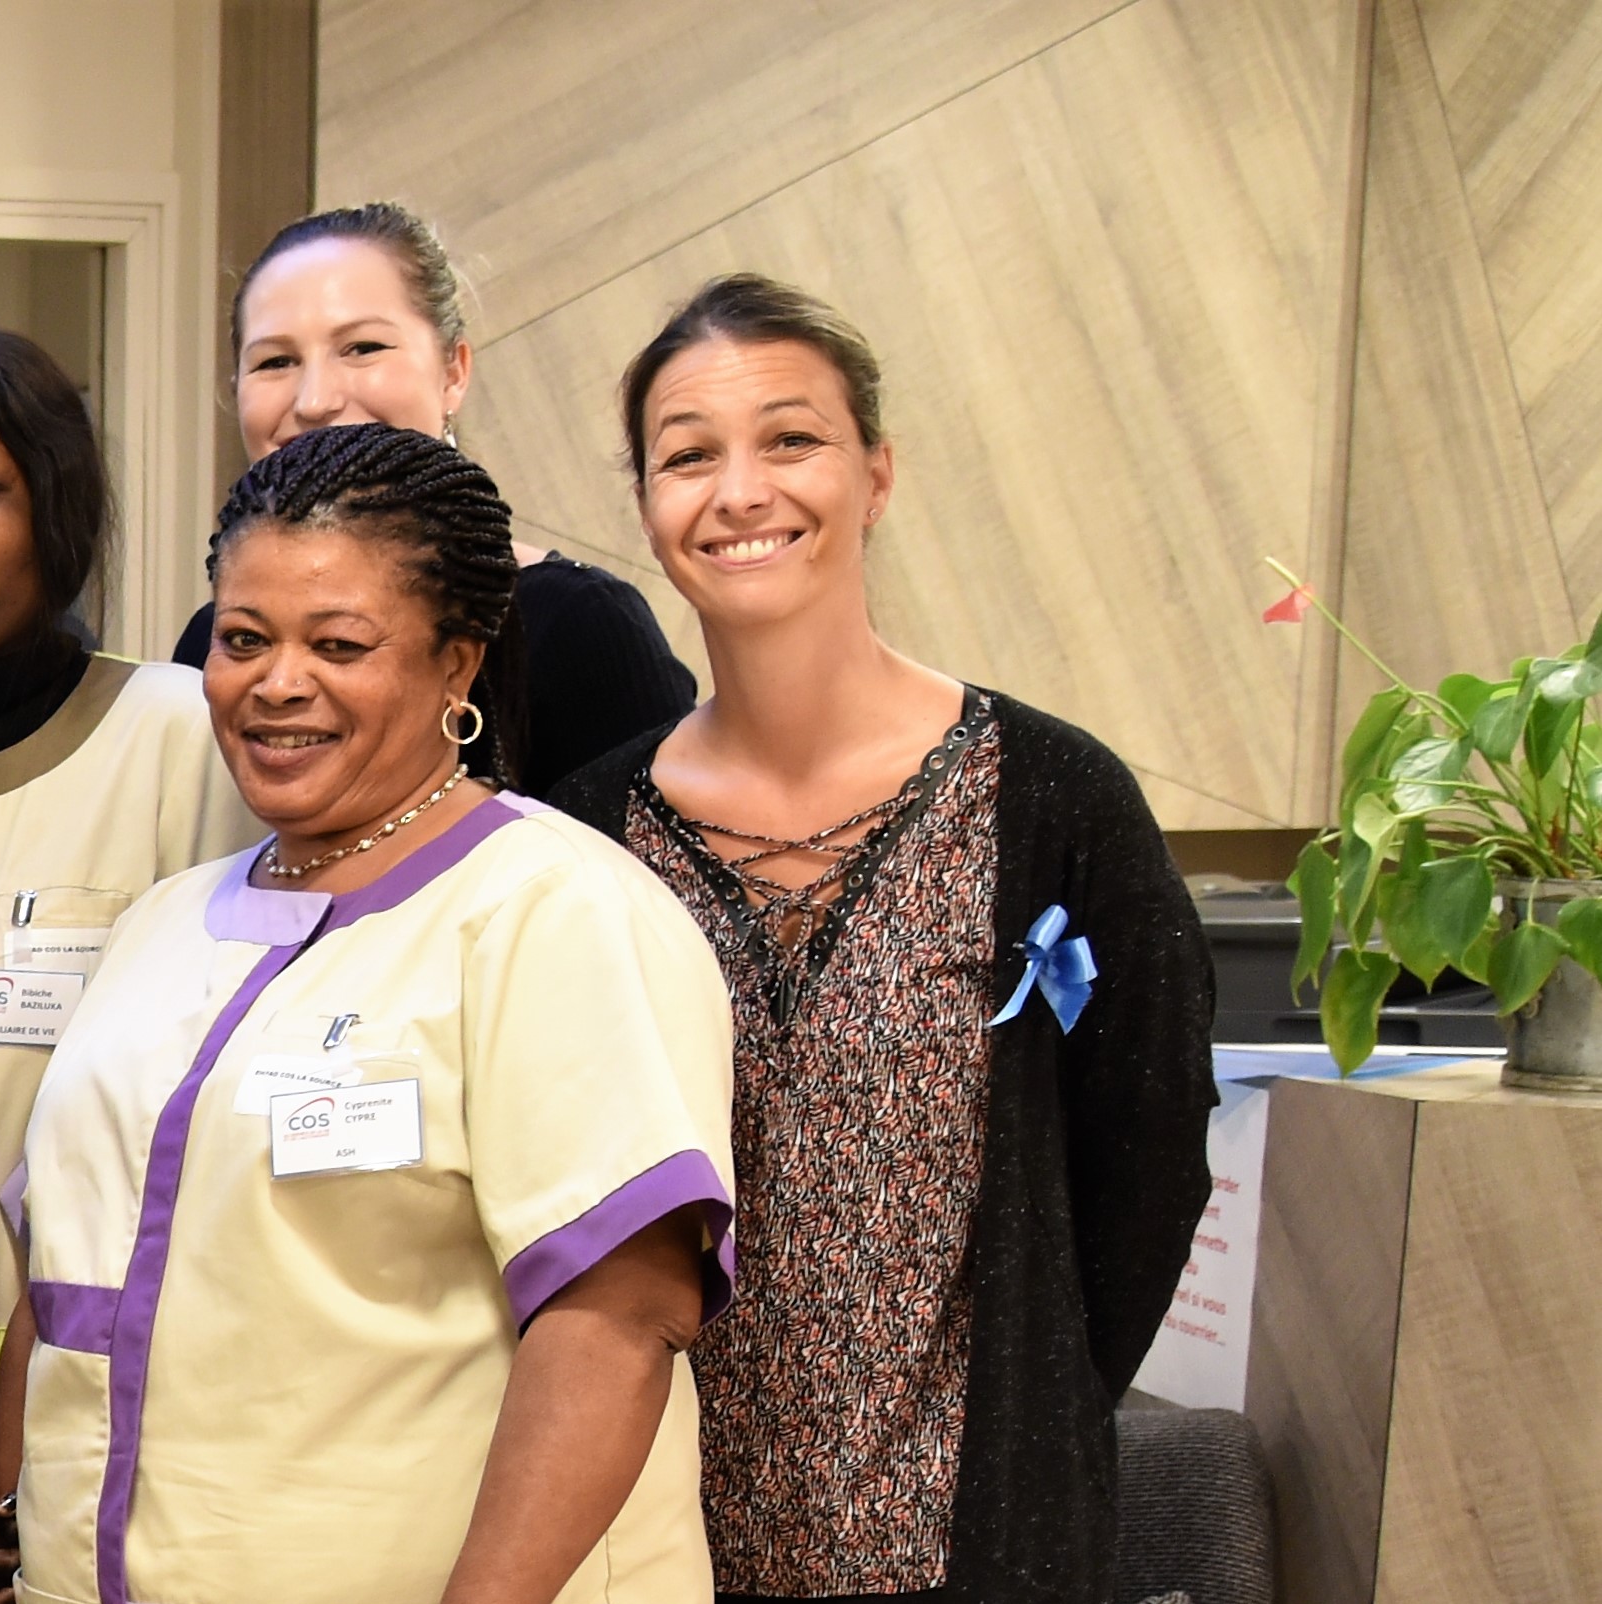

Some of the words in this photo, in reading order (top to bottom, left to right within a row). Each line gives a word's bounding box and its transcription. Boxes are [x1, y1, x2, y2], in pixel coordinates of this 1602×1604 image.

[28, 1027, 40, 1035] DE
[42, 1027, 56, 1036] VIE
[288, 1113, 330, 1131] COS
[336, 1148, 356, 1158] ASH
